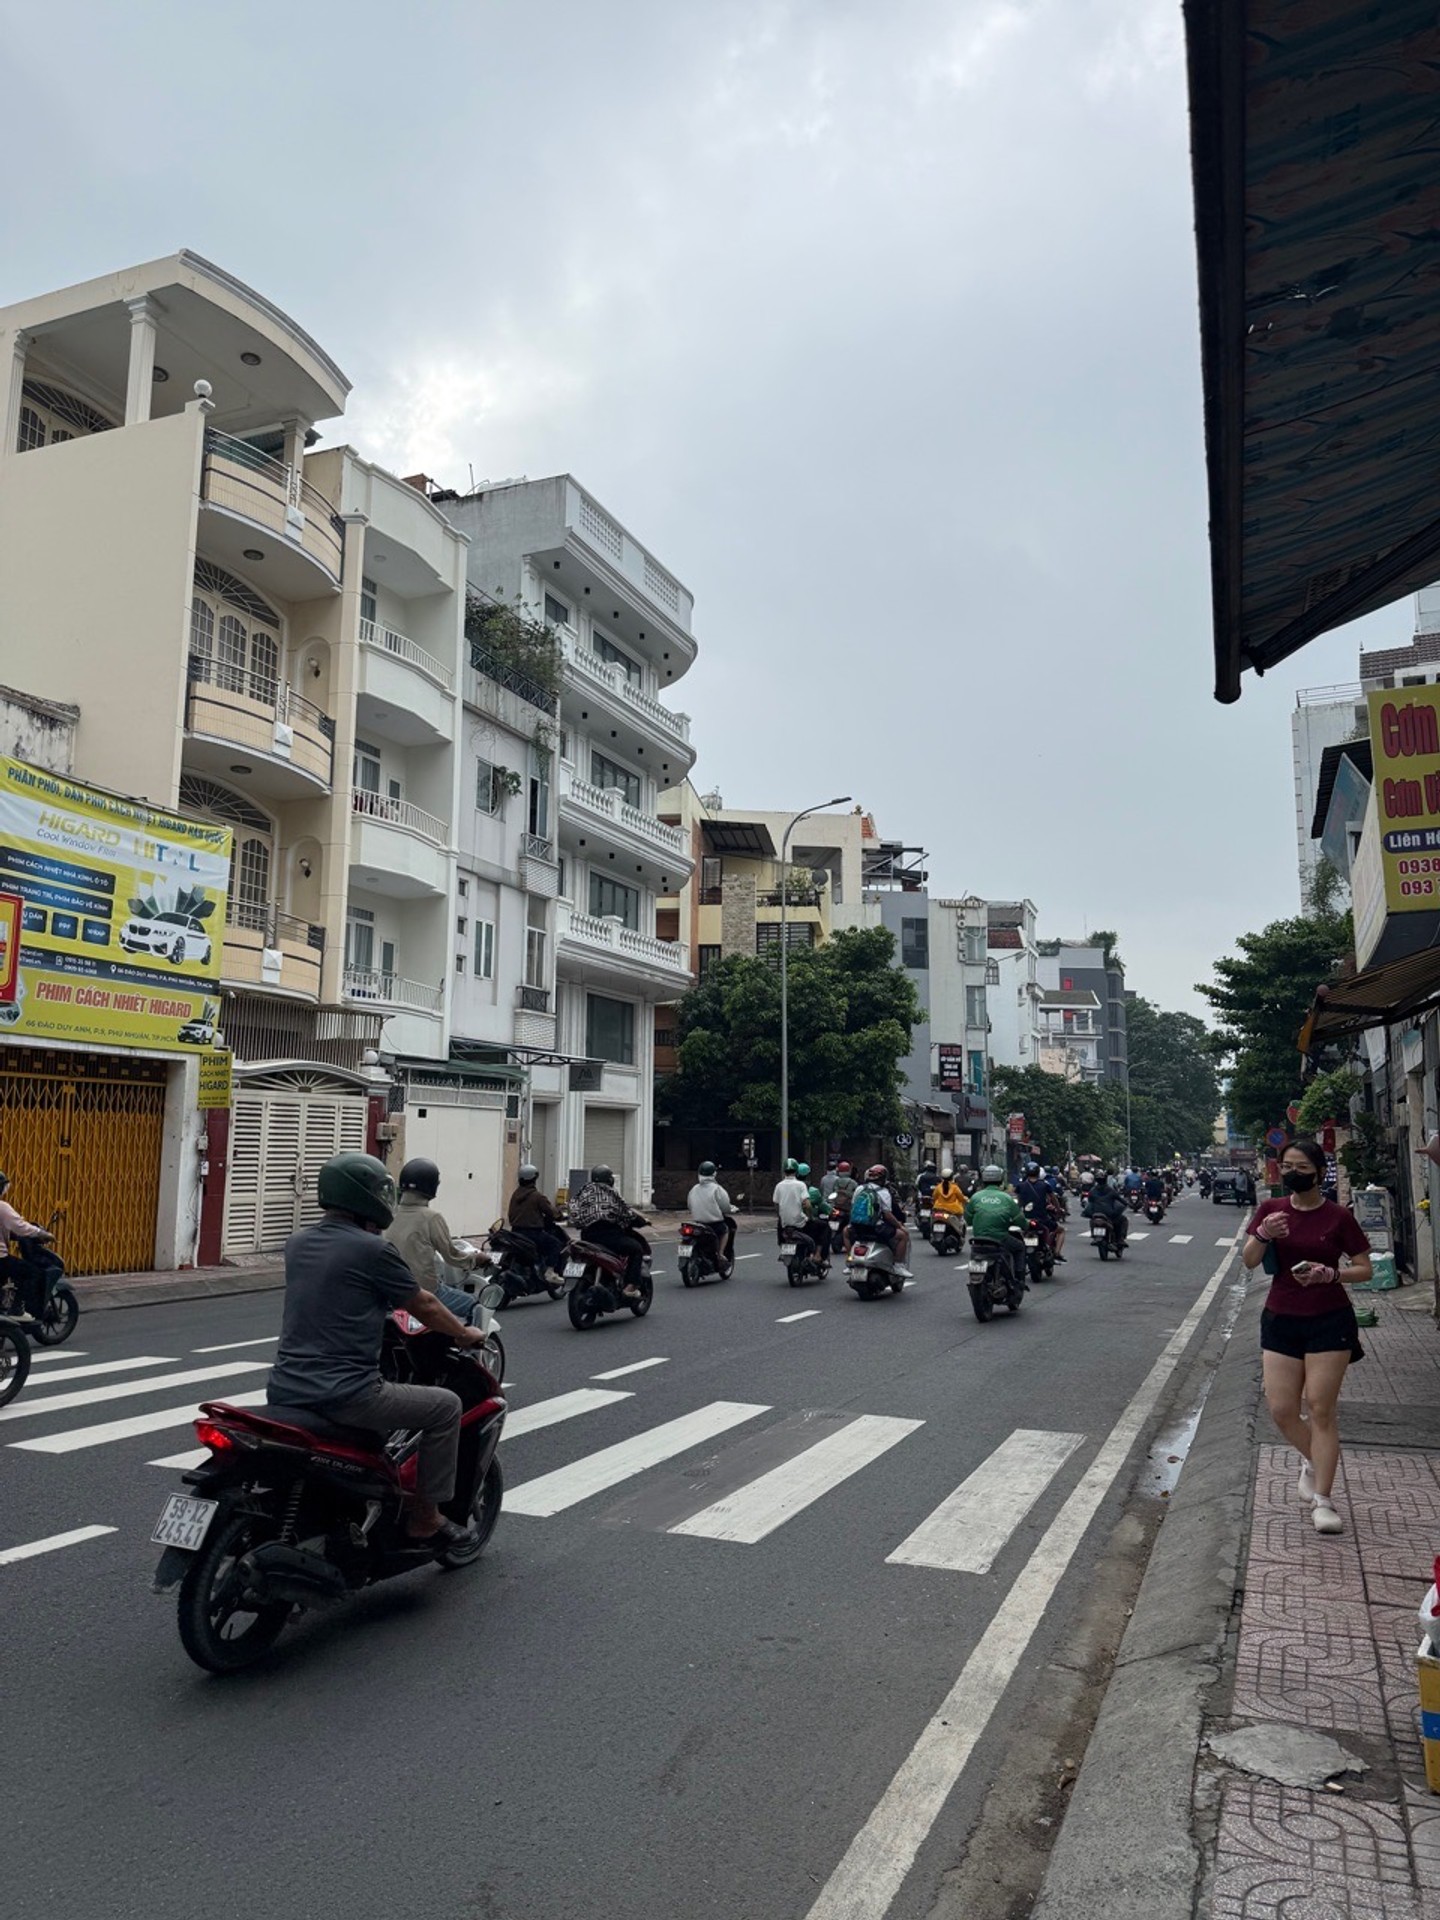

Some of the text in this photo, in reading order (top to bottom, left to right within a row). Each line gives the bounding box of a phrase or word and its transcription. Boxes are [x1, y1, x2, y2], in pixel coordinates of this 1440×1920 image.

[1381, 702, 1440, 759] Cơm
[8, 766, 36, 788] PHÂN
[85, 793, 107, 810] PHIM
[1383, 777, 1424, 819] Cơm
[36, 828, 60, 842] Cool
[39, 810, 121, 848] HIGARD
[7, 855, 25, 866] PHIM
[25, 859, 43, 870] CÁCH
[1, 881, 20, 891] PHIM
[1401, 879, 1434, 896] 093
[36, 981, 192, 1019] PHIM CÁCH NHIỆT HIGARD
[202, 1056, 228, 1066] PHIM
[200, 1080, 229, 1091] HIGARD
[980, 1195, 1002, 1206] Grab
